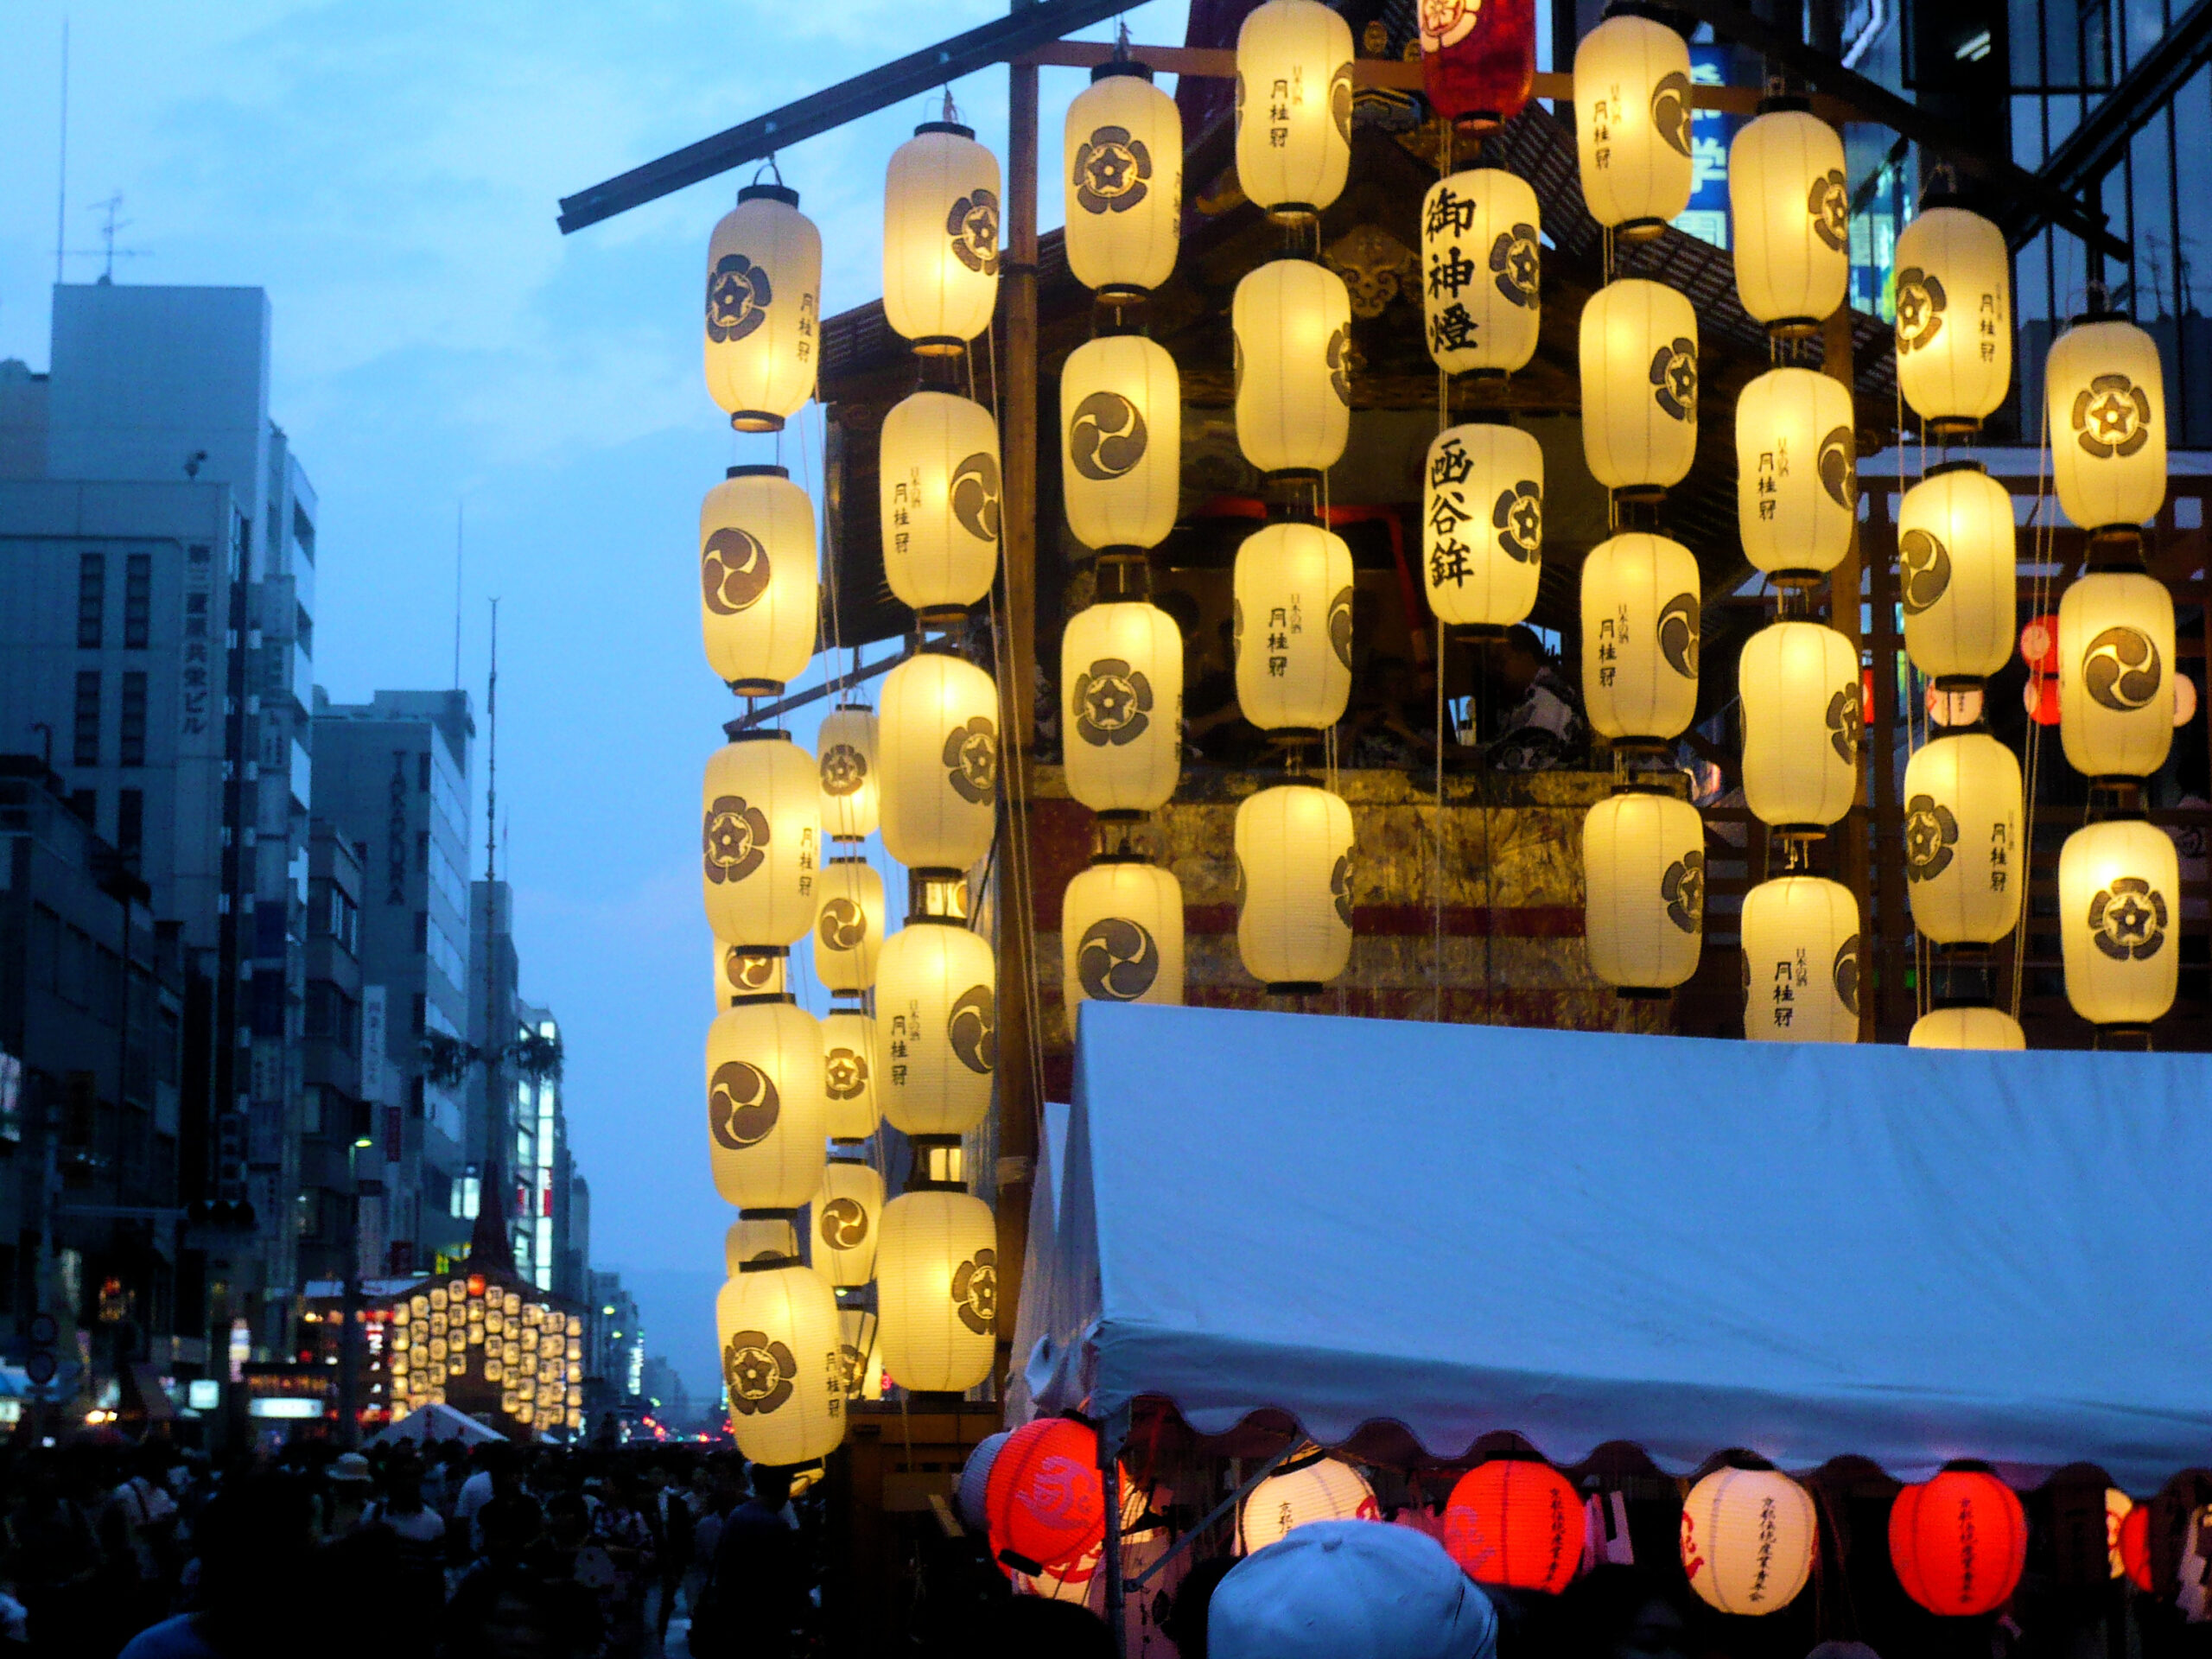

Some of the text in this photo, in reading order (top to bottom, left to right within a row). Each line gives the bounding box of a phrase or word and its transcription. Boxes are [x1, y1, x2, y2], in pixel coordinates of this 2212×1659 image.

[1270, 79, 1289, 148] 月桂冠
[1593, 100, 1611, 169] 月桂冠
[1427, 188, 1479, 353] 御神燈
[1980, 294, 1995, 363] 月桂冠
[893, 483, 909, 554] 月桂冠
[1429, 438, 1474, 588] 函谷鉾
[1758, 453, 1776, 521] 月桂冠
[1268, 607, 1287, 677] 月桂冠
[1599, 619, 1617, 688] 月桂冠
[799, 828, 813, 897] 月桂冠
[1990, 823, 2006, 893] 月桂冠
[1774, 961, 1795, 1028] 月桂冠
[891, 1014, 907, 1085] 月桂冠
[827, 1351, 840, 1419] 月桂冠
